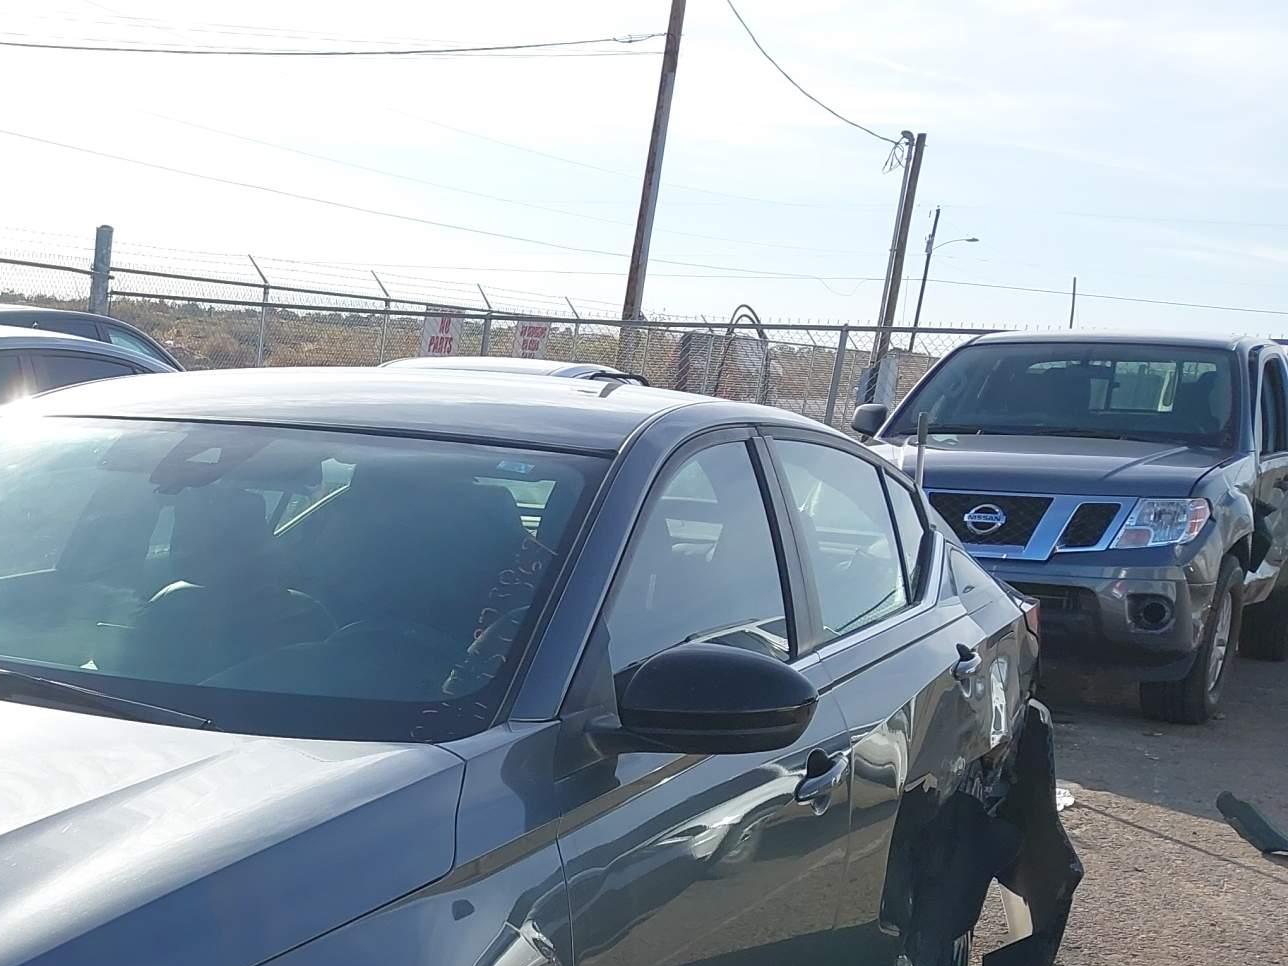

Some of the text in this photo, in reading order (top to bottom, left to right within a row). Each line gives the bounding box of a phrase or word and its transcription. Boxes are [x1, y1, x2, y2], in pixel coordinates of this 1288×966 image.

[439, 317, 452, 334] NO
[428, 336, 453, 354] PARTS
[967, 514, 1001, 522] NISSAN
